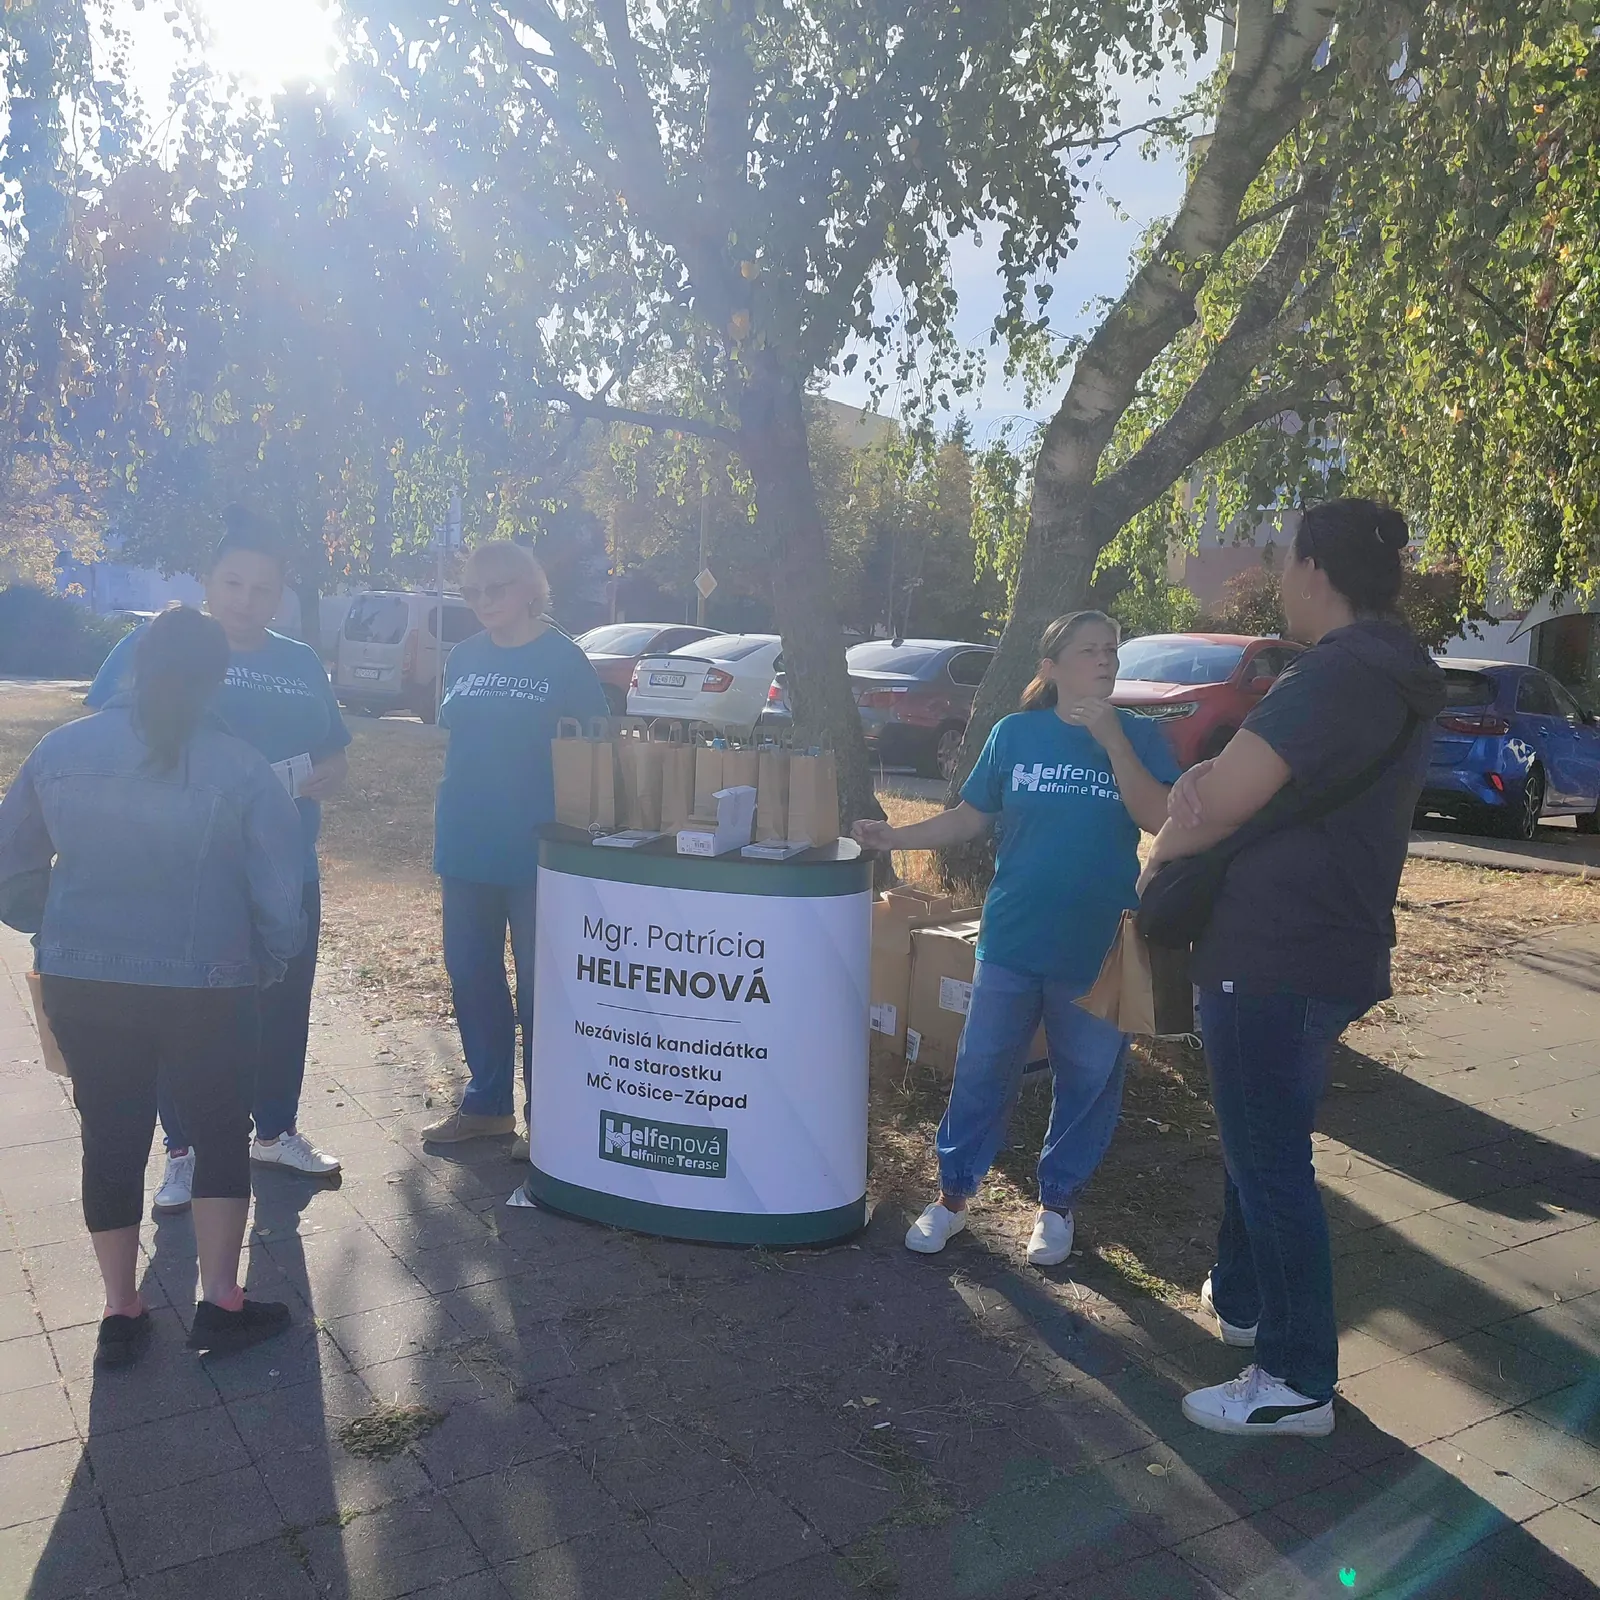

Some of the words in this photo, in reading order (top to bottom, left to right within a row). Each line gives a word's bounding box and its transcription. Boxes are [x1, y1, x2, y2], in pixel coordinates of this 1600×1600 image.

[226, 666, 308, 689] elfenová
[447, 673, 549, 696] Helfenová
[1090, 785, 1122, 801] Tera
[583, 915, 638, 951] Mgr.
[648, 924, 765, 959] Patrícia
[576, 954, 771, 1004] HELFENOVÁ
[575, 1020, 651, 1048] Nezávislá
[656, 1034, 768, 1060] kandidátka
[608, 1054, 630, 1069] na
[633, 1058, 722, 1082] starostku
[586, 1071, 612, 1091] MČ
[616, 1078, 748, 1111] Košice-Západ
[605, 1118, 720, 1157] Helfenová
[676, 1154, 720, 1171] Terase
